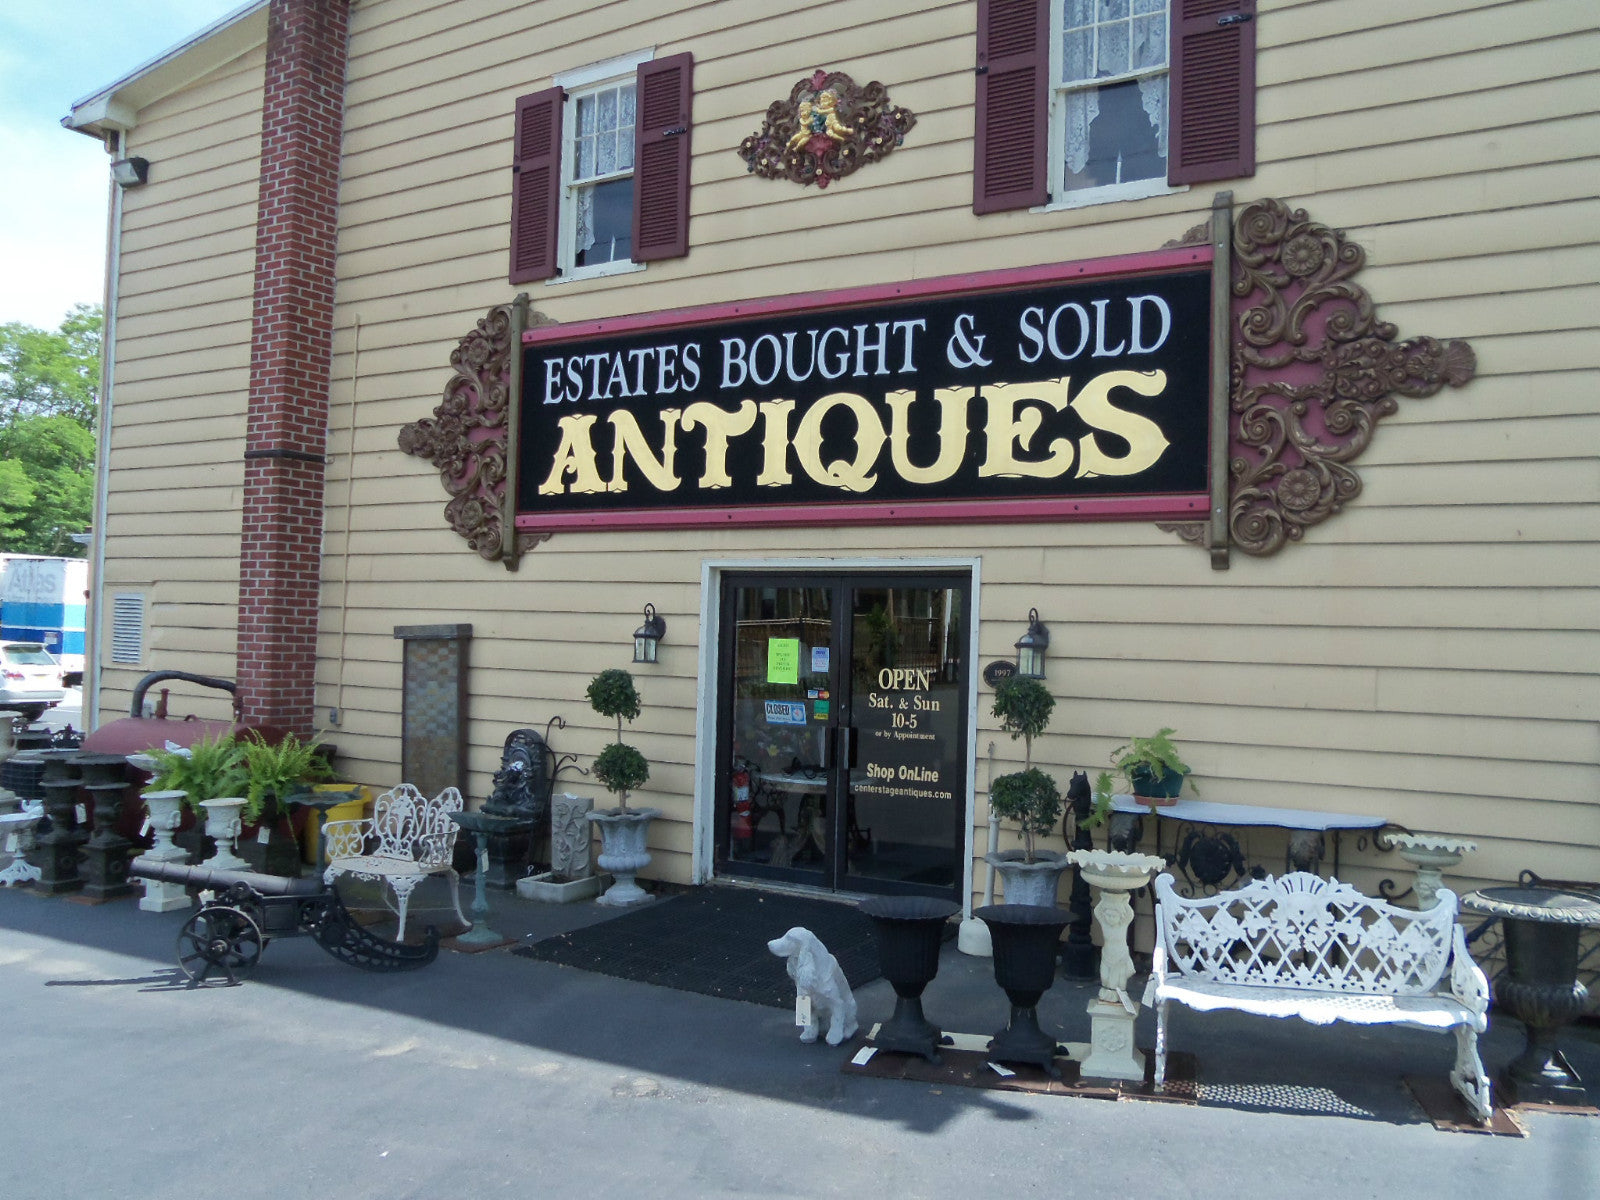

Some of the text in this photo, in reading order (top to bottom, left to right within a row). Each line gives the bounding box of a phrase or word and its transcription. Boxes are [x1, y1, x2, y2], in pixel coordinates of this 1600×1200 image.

[543, 294, 1171, 405] ESTATES BOUGHT & SOLD
[538, 369, 1171, 496] ANTIQUES
[878, 668, 931, 691] OPEN
[766, 703, 790, 716] CLOSED
[868, 692, 940, 711] Sat. & Sun
[891, 712, 918, 729] 10-5
[884, 730, 892, 738] by
[894, 731, 935, 740] Appointment
[866, 762, 939, 782] Shop OnLine
[854, 783, 952, 800] centerstageantiques.com
